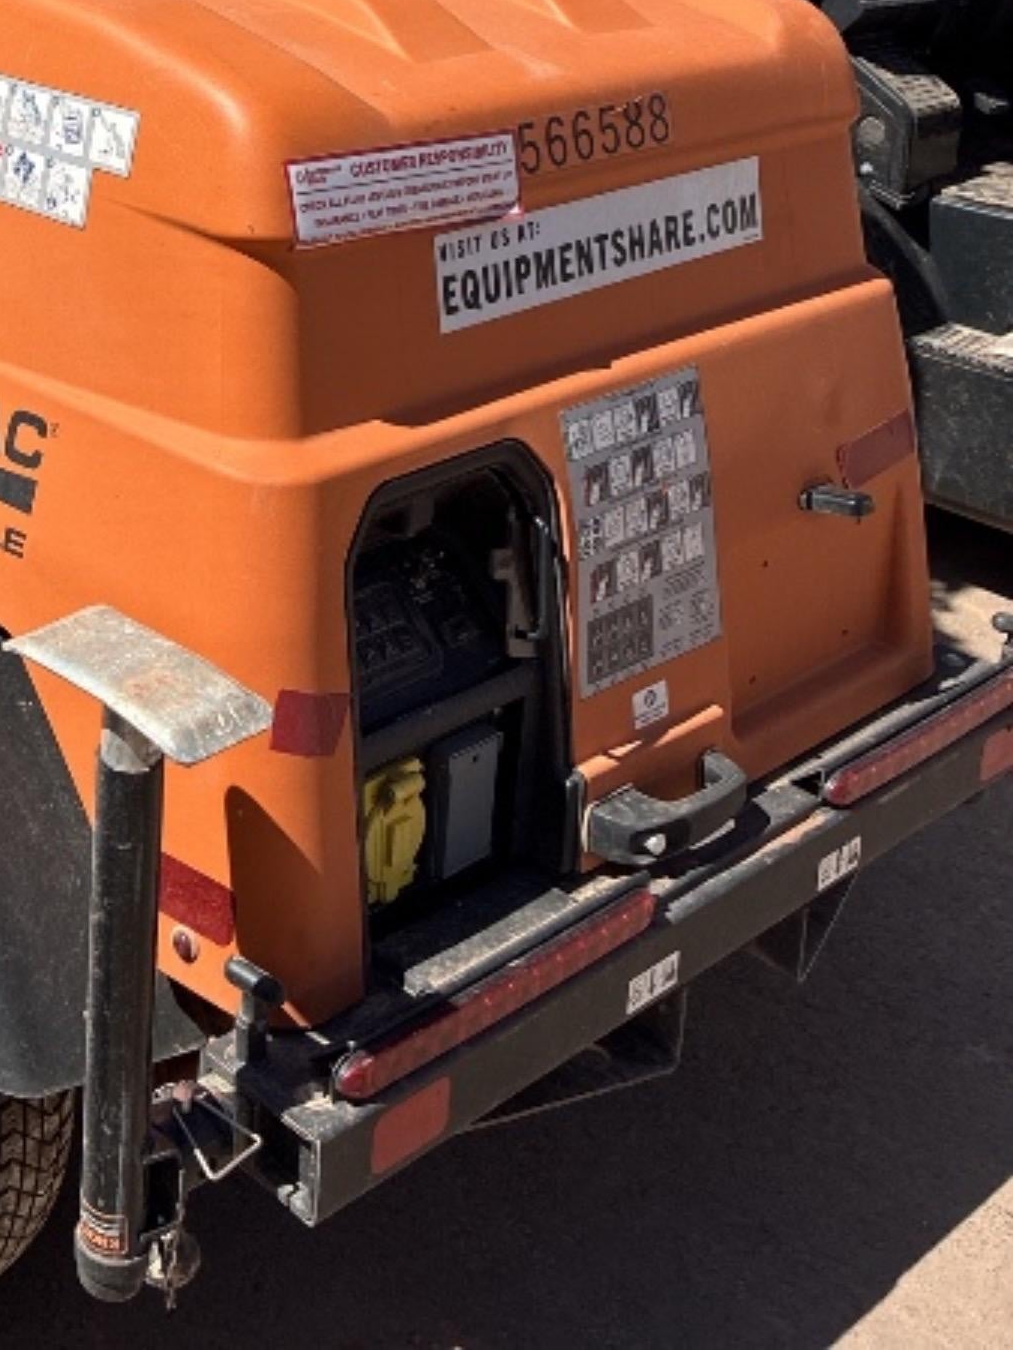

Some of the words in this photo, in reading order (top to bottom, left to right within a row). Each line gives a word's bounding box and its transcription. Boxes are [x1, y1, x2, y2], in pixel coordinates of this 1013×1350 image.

[518, 93, 670, 174] 566588
[440, 235, 482, 262] VISIT
[490, 227, 511, 250] US
[518, 220, 541, 242] AT:
[442, 191, 758, 316] EQUIPMENTSHARE.COM
